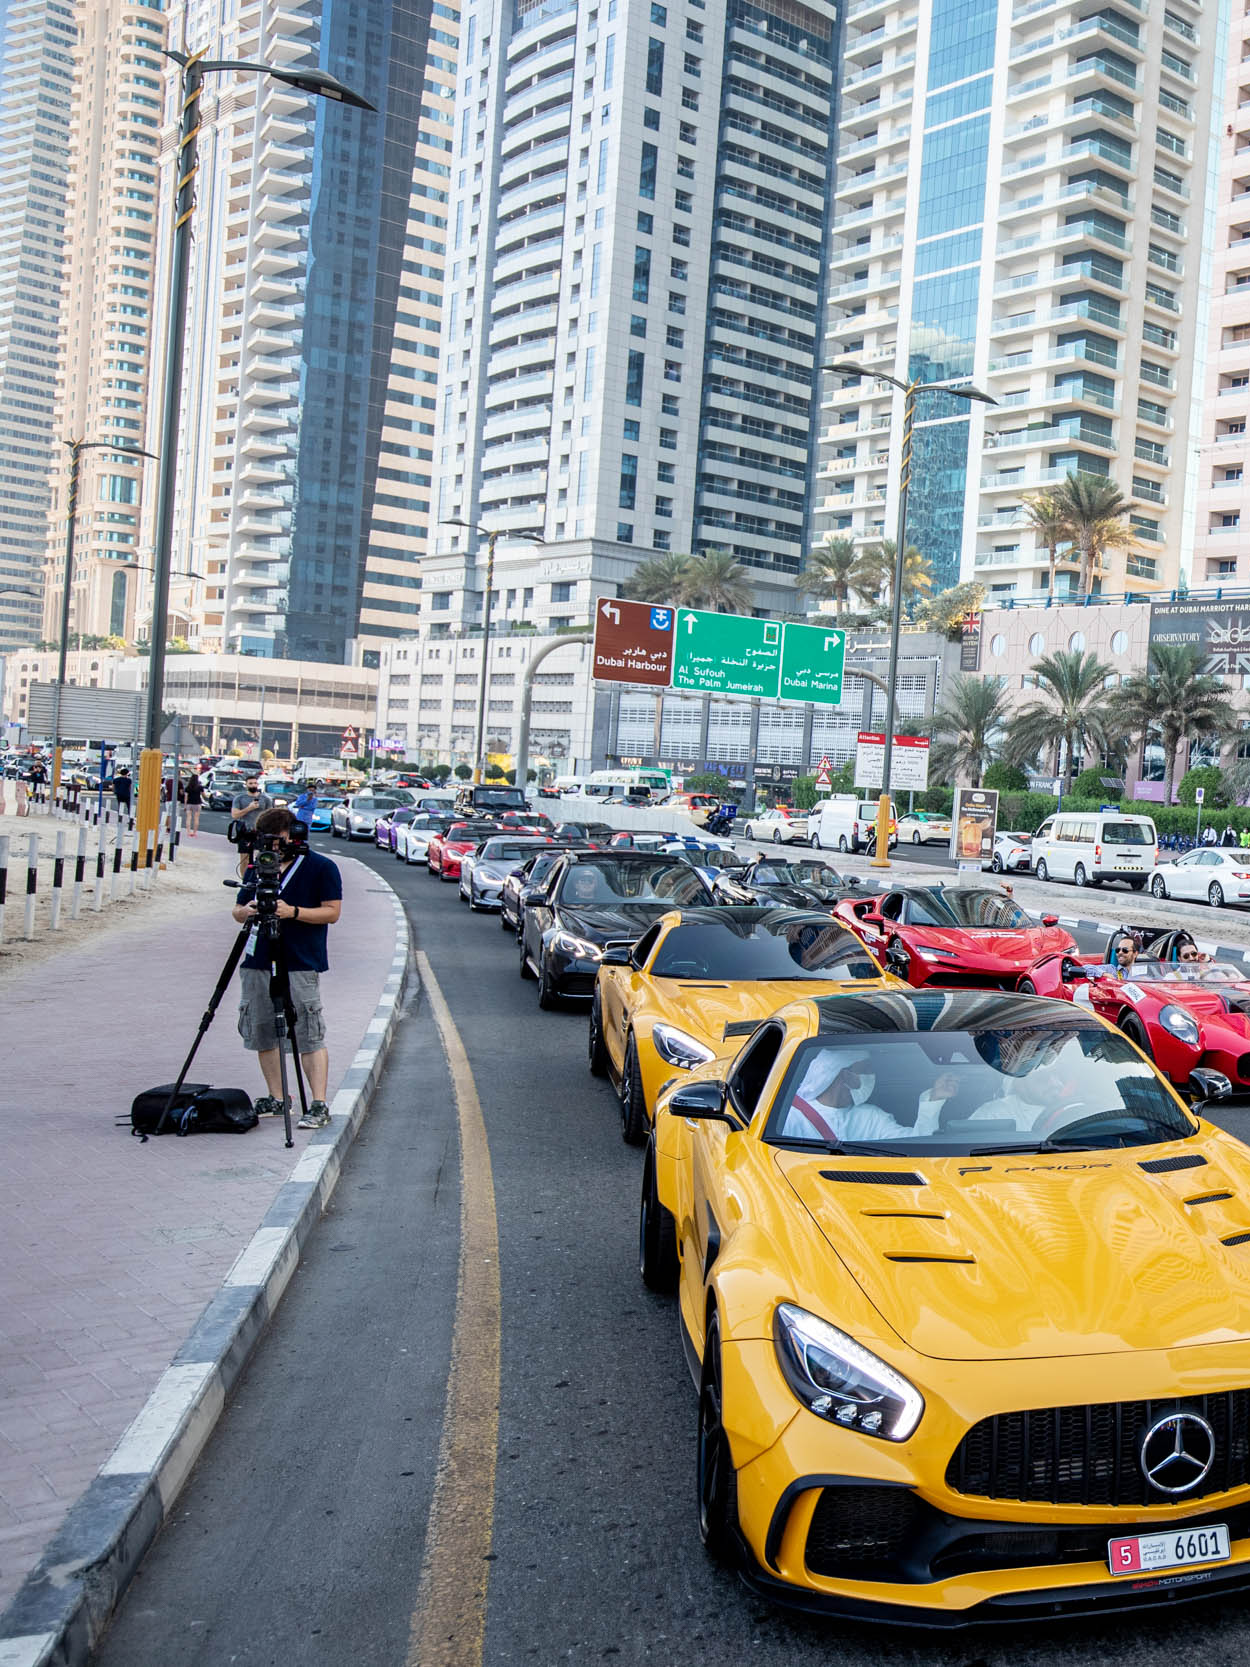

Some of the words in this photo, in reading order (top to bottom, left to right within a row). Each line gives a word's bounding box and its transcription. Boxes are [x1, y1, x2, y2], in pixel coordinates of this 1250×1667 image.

[1154, 607, 1170, 615] DINE
[1170, 606, 1180, 614] AT
[1180, 605, 1199, 613] DUBAI
[1200, 604, 1234, 613] MARRIOTT
[1152, 632, 1201, 643] OBSERVATORY
[622, 646, 647, 656] هاربر
[650, 651, 667, 661] دبي
[746, 648, 778, 657] الصفوح
[597, 655, 625, 667] Dubai
[628, 659, 667, 672] Harbour
[679, 665, 688, 674] Al
[694, 667, 726, 678] Sufouh
[679, 675, 695, 685] The
[699, 678, 722, 688] Palm
[726, 681, 764, 692] Jumeirah
[784, 677, 808, 688] Dubai
[811, 680, 838, 691] Marina
[1005, 1163, 1113, 1173] PRIOR
[1120, 1545, 1132, 1565] 5
[1175, 1531, 1221, 1559] 6601
